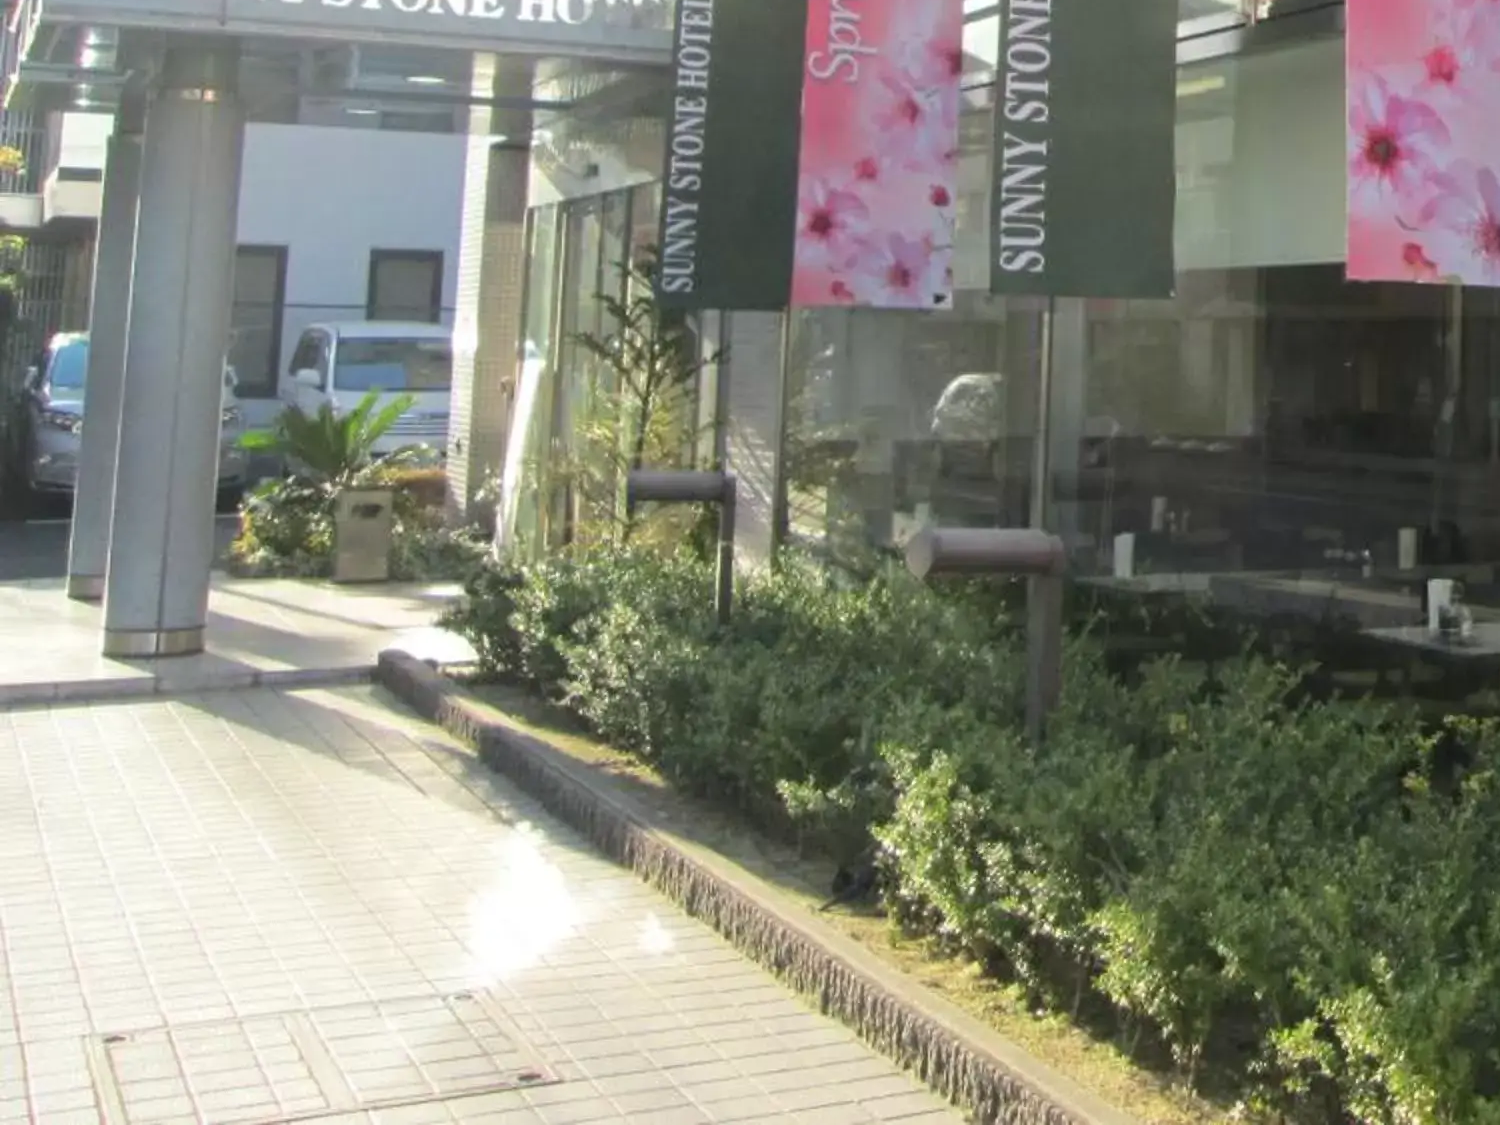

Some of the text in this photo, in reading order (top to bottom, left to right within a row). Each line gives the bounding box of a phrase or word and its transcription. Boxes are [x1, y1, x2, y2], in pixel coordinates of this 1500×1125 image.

[669, 92, 708, 191] STONE
[661, 195, 698, 293] SUNNY
[1000, 138, 1049, 273] SUNNY
